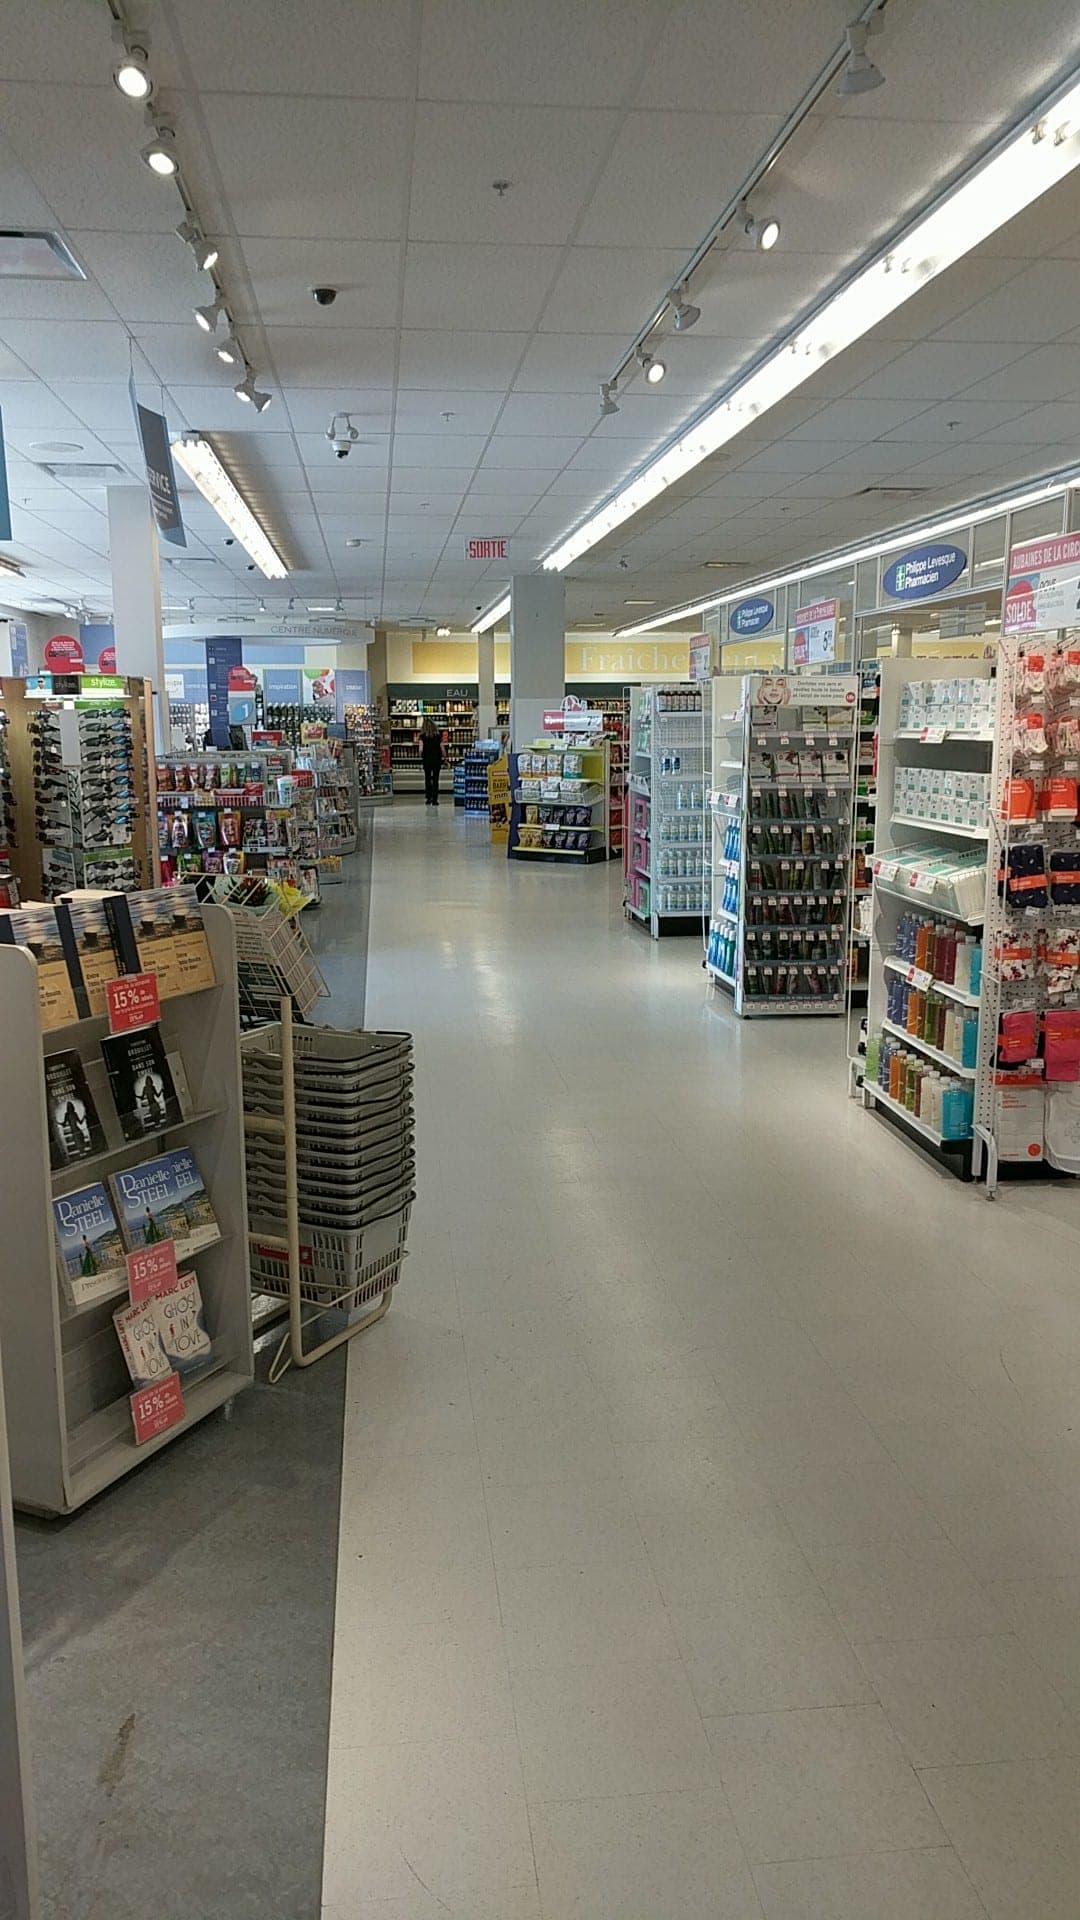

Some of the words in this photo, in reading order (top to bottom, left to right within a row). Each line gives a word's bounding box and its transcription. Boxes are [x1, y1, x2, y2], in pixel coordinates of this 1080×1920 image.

[469, 540, 507, 559] SORTIE
[1012, 548, 1042, 570] AUBAINES
[1043, 547, 1053, 564] DE
[1053, 545, 1061, 561] LA
[905, 559, 927, 575] Philippe
[905, 570, 939, 589] Pharmacien
[1006, 600, 1033, 624] SOLDE
[270, 625, 312, 634] CENTRE
[269, 683, 297, 691] inspiration
[446, 688, 468, 697] EAU
[113, 988, 140, 1009] 15%
[120, 1170, 171, 1194] Danielle
[126, 1183, 174, 1209] STEEL
[57, 1194, 105, 1221] Danielle
[63, 1209, 109, 1237] STEEL
[133, 1257, 159, 1280] 15%
[155, 1287, 179, 1300] MARC
[125, 1307, 141, 1322] MARC
[139, 1394, 165, 1420] 15%
